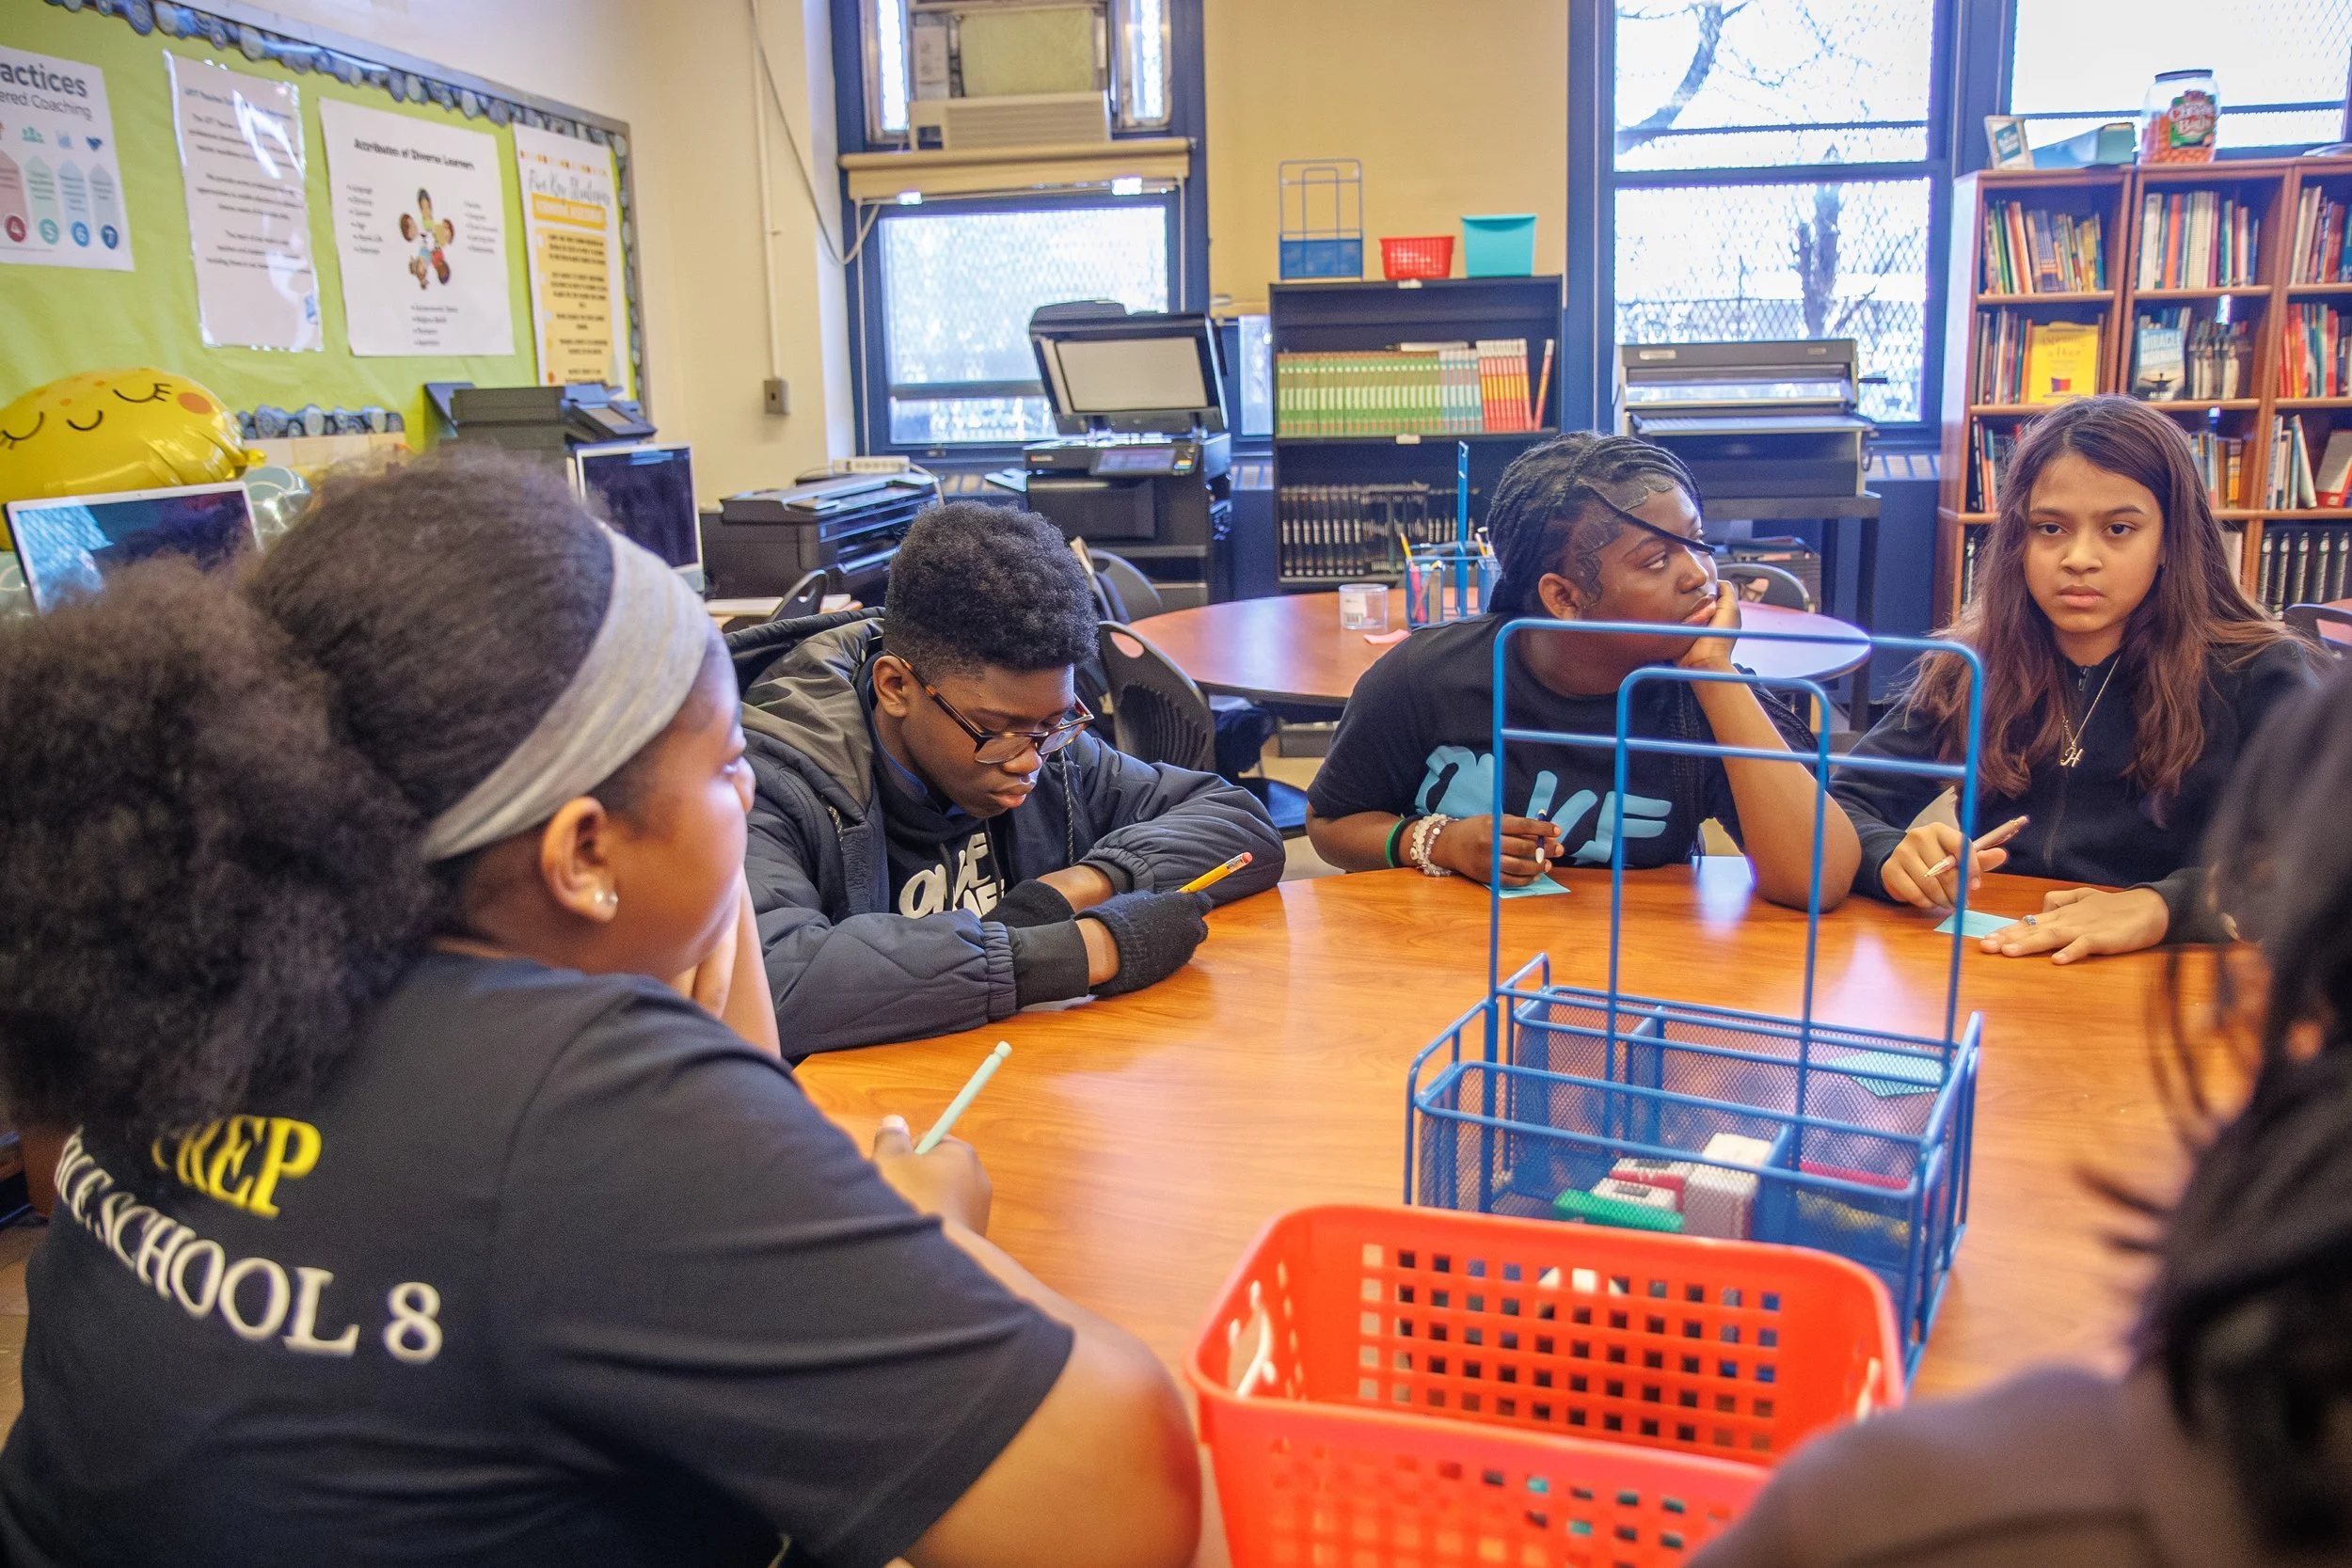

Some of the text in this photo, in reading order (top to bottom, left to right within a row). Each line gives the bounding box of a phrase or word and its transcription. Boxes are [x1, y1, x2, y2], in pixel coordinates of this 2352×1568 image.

[31, 94, 91, 121] Coaching
[95, 1192, 360, 1357] SCHOOL
[384, 1281, 443, 1364] 8
